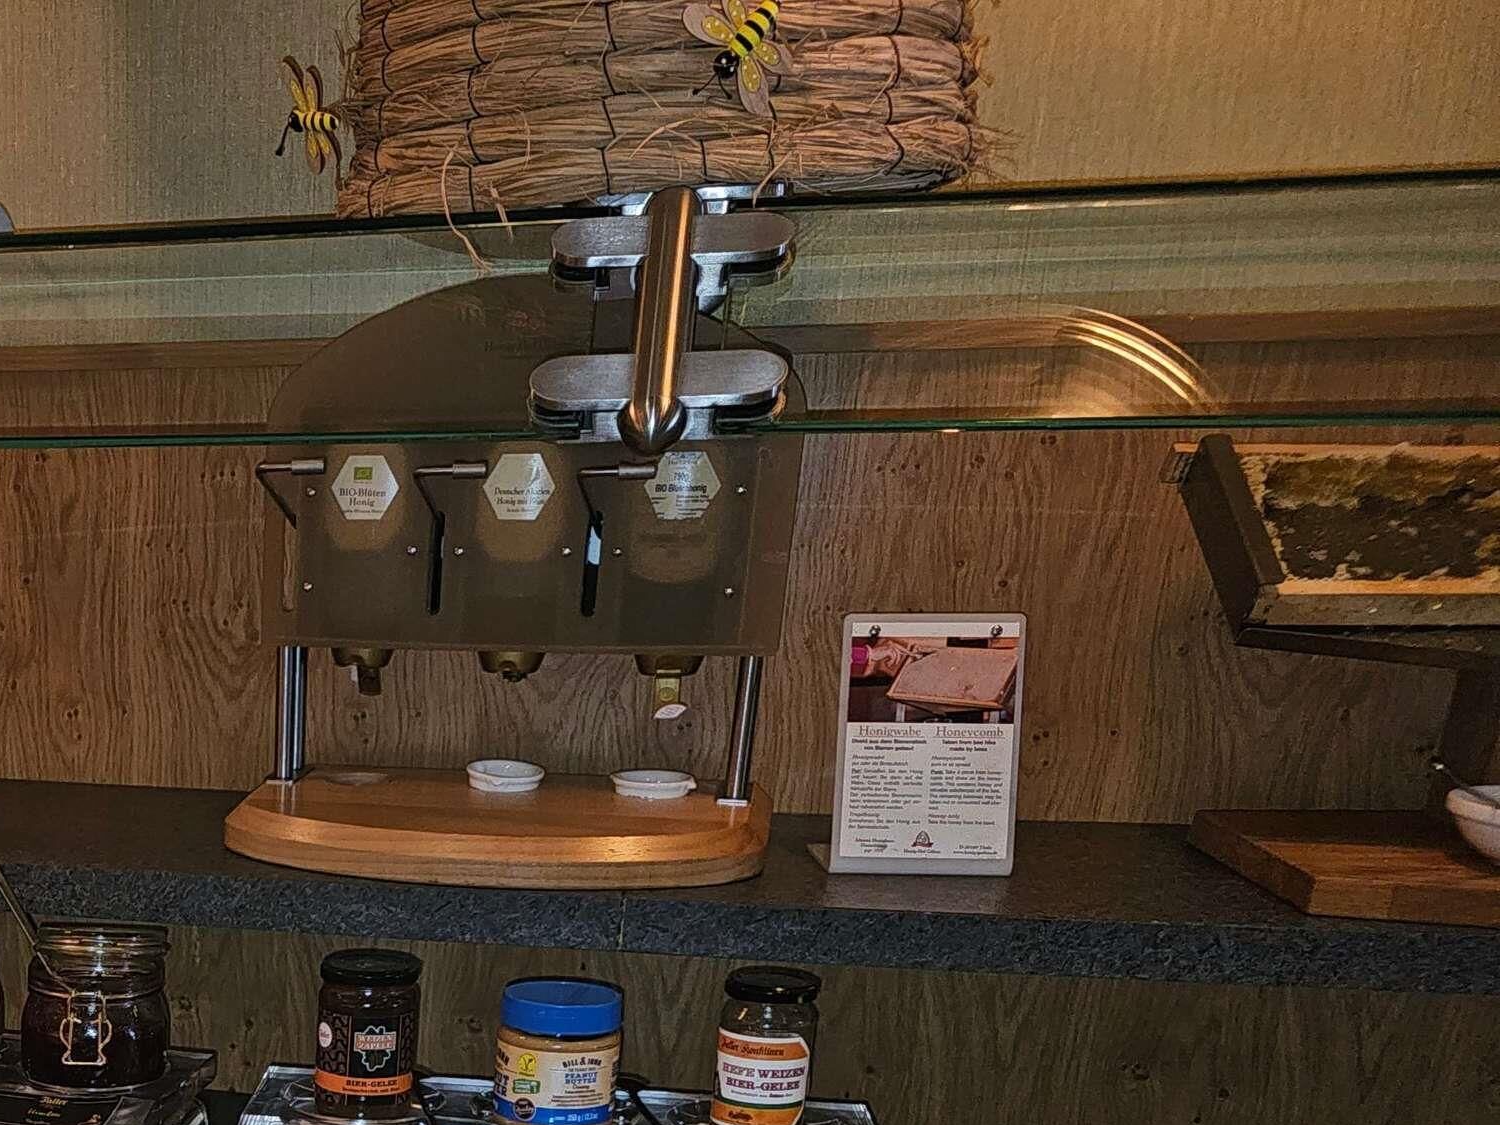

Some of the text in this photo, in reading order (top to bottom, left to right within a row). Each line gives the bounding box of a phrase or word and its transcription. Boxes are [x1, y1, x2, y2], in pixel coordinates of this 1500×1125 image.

[859, 725, 922, 737] Honigwabe
[935, 726, 1004, 737] Honeycomb
[722, 1062, 806, 1078] HEFE WEIZEN
[726, 1077, 800, 1091] BIER-GELEE
